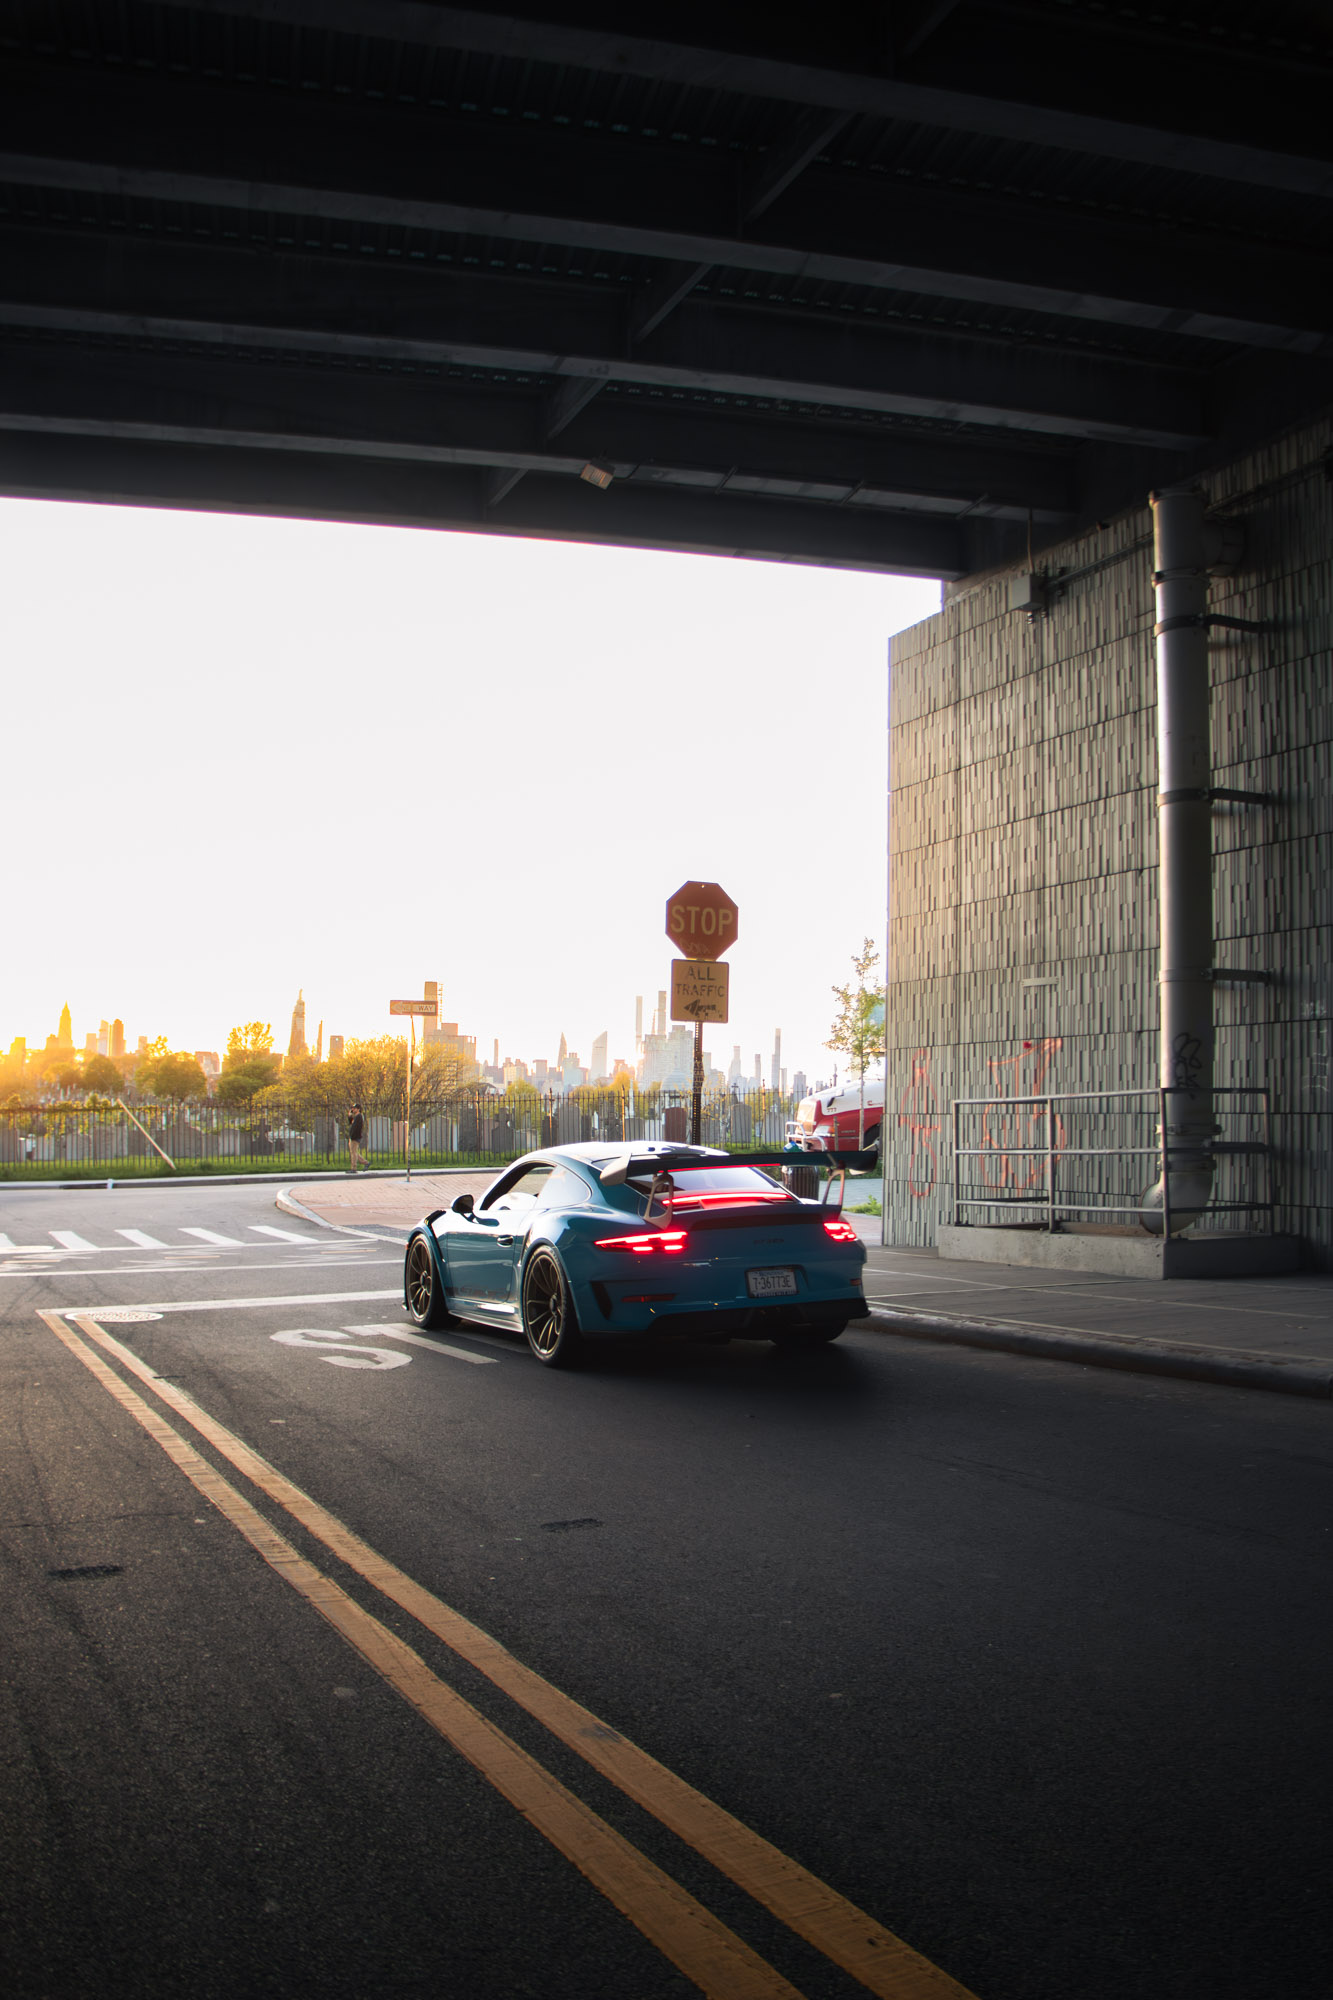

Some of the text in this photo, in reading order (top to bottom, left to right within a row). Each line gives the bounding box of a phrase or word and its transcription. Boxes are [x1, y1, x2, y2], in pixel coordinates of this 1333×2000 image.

[671, 905, 733, 936] STOP
[685, 967, 716, 981] ALL
[676, 983, 725, 998] TRAFFIC
[417, 1004, 434, 1012] WAY
[269, 1323, 505, 1370] ST
